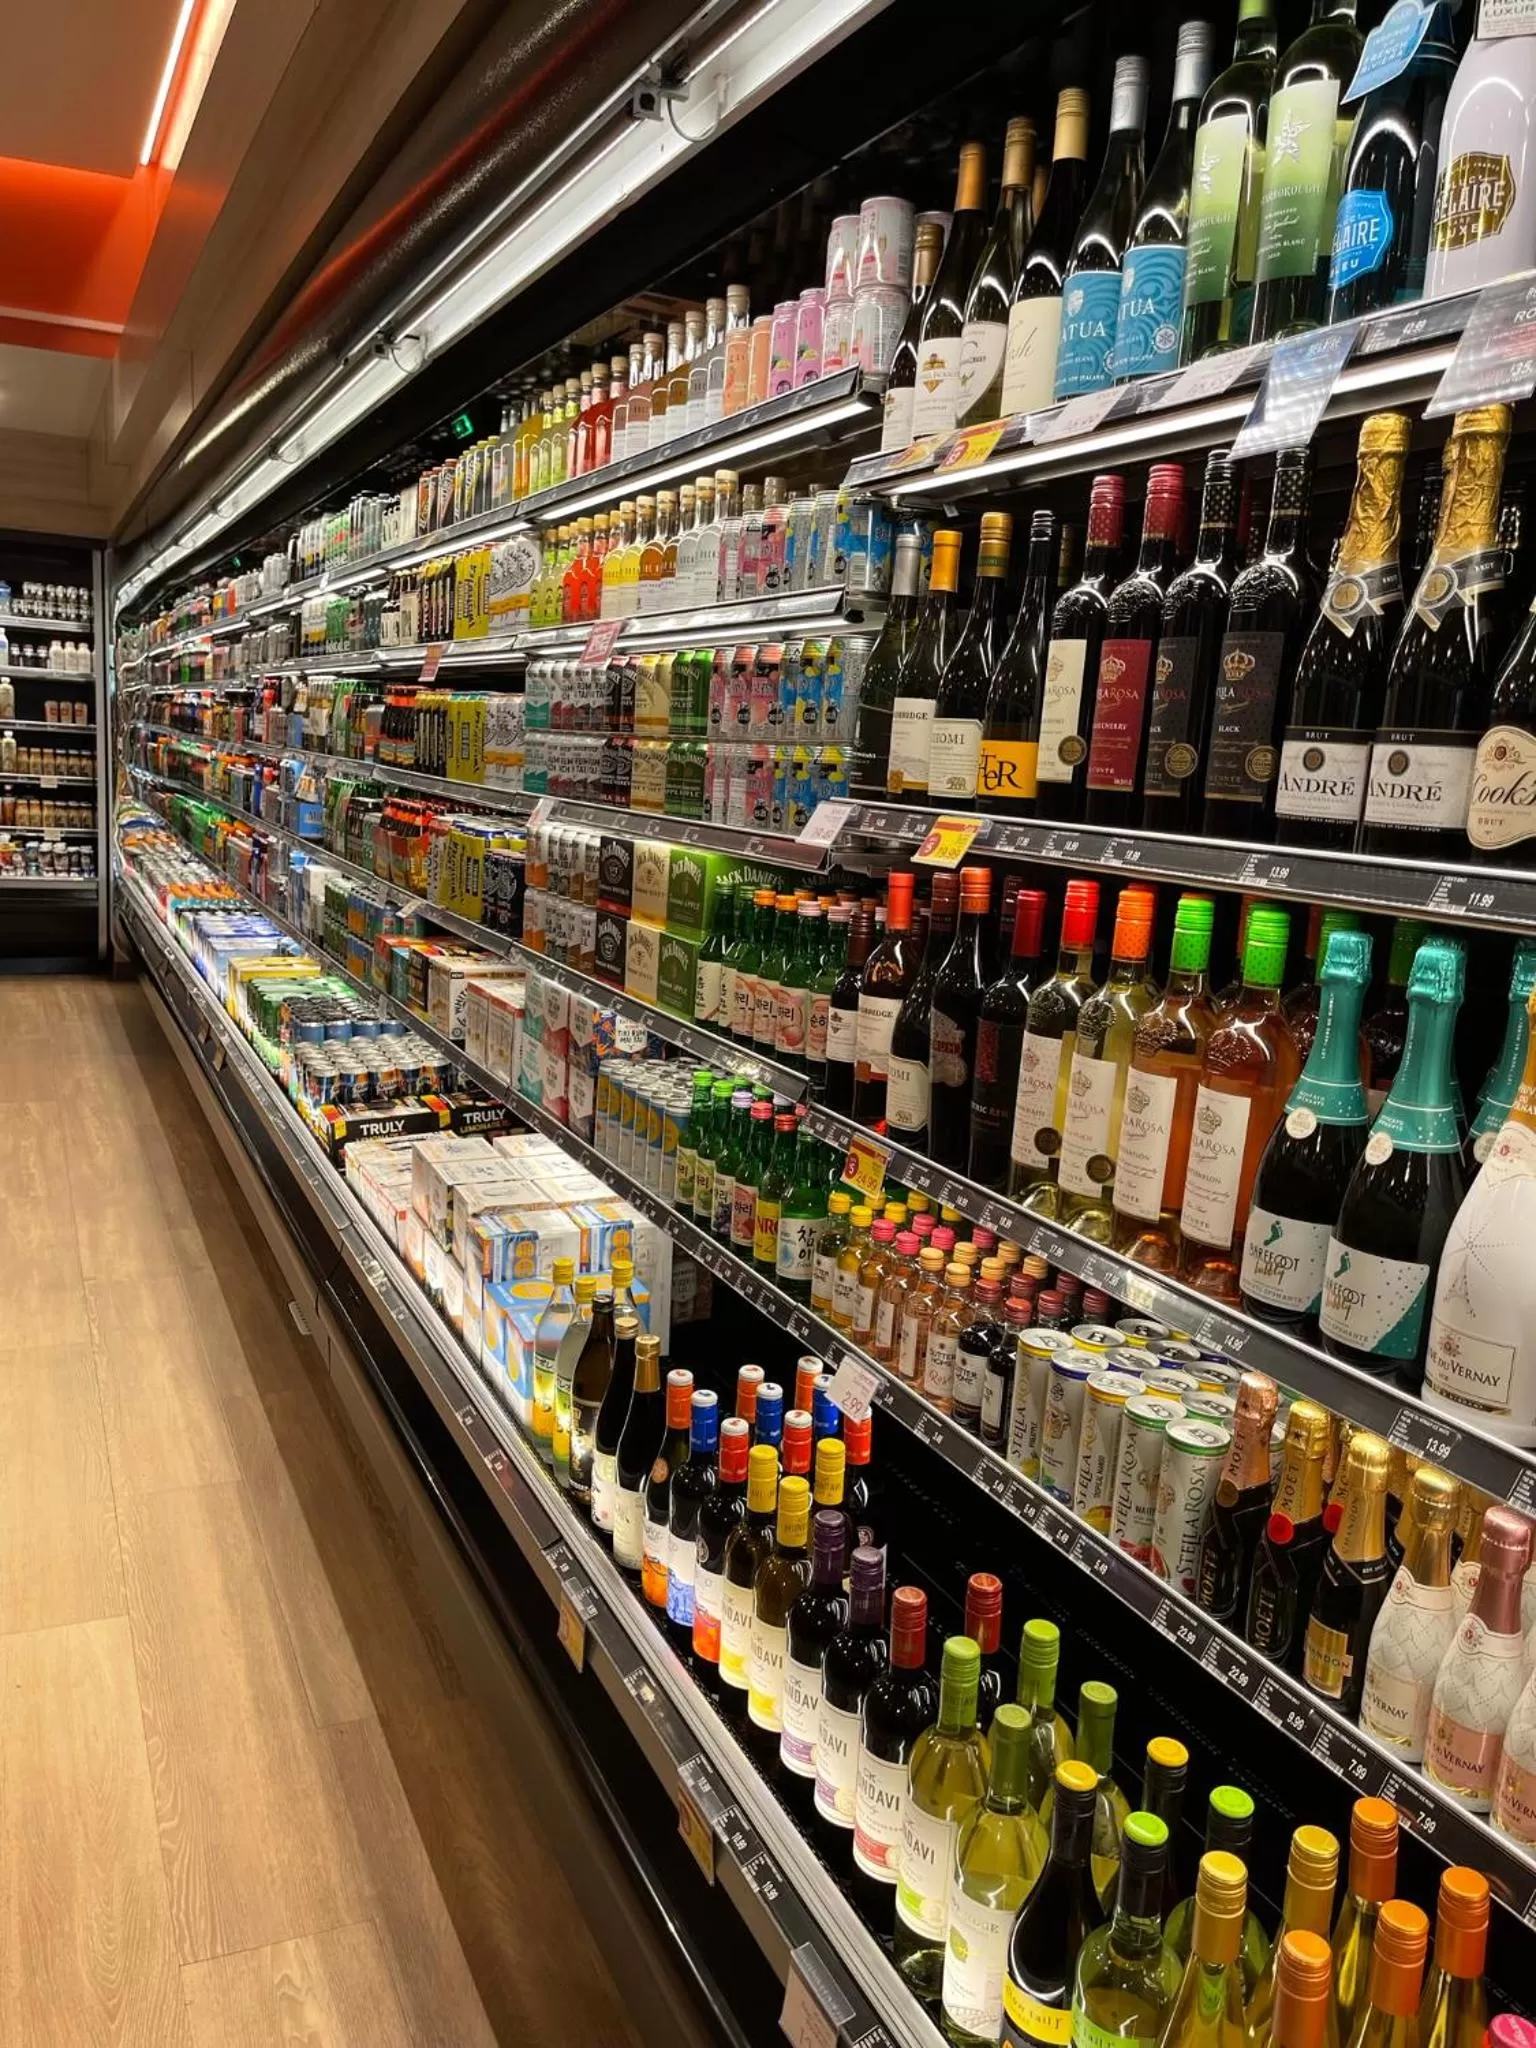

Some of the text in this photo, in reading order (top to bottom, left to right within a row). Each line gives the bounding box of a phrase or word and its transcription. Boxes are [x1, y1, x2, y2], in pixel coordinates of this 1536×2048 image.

[1305, 732, 1330, 740] BRUT
[1391, 734, 1416, 742] BRUT
[1279, 772, 1356, 797] ANDRÉ
[1368, 778, 1444, 802] ANDRÉ
[1467, 892, 1494, 908] 11.99
[360, 1119, 405, 1137] TRULY
[463, 1108, 507, 1125] TRULY
[1449, 1359, 1502, 1388] VERNAY
[1011, 1405, 1026, 1459] STELLA
[1425, 1437, 1451, 1460] 13.99
[1077, 1453, 1092, 1510] STELLA
[1115, 1431, 1138, 1538] STELLA ROSA
[1177, 1464, 1206, 1577] STELLA ROSA
[1176, 1624, 1197, 1646] 22.99
[1228, 1665, 1250, 1688] 22.99
[1371, 1697, 1409, 1721] VERNAY
[1286, 1711, 1305, 1732] 9.99
[1348, 1759, 1368, 1782] 7.99
[1443, 1749, 1486, 1775] VERNAY
[1511, 1798, 1536, 1821] VERN
[1416, 1811, 1437, 1835] 7.99
